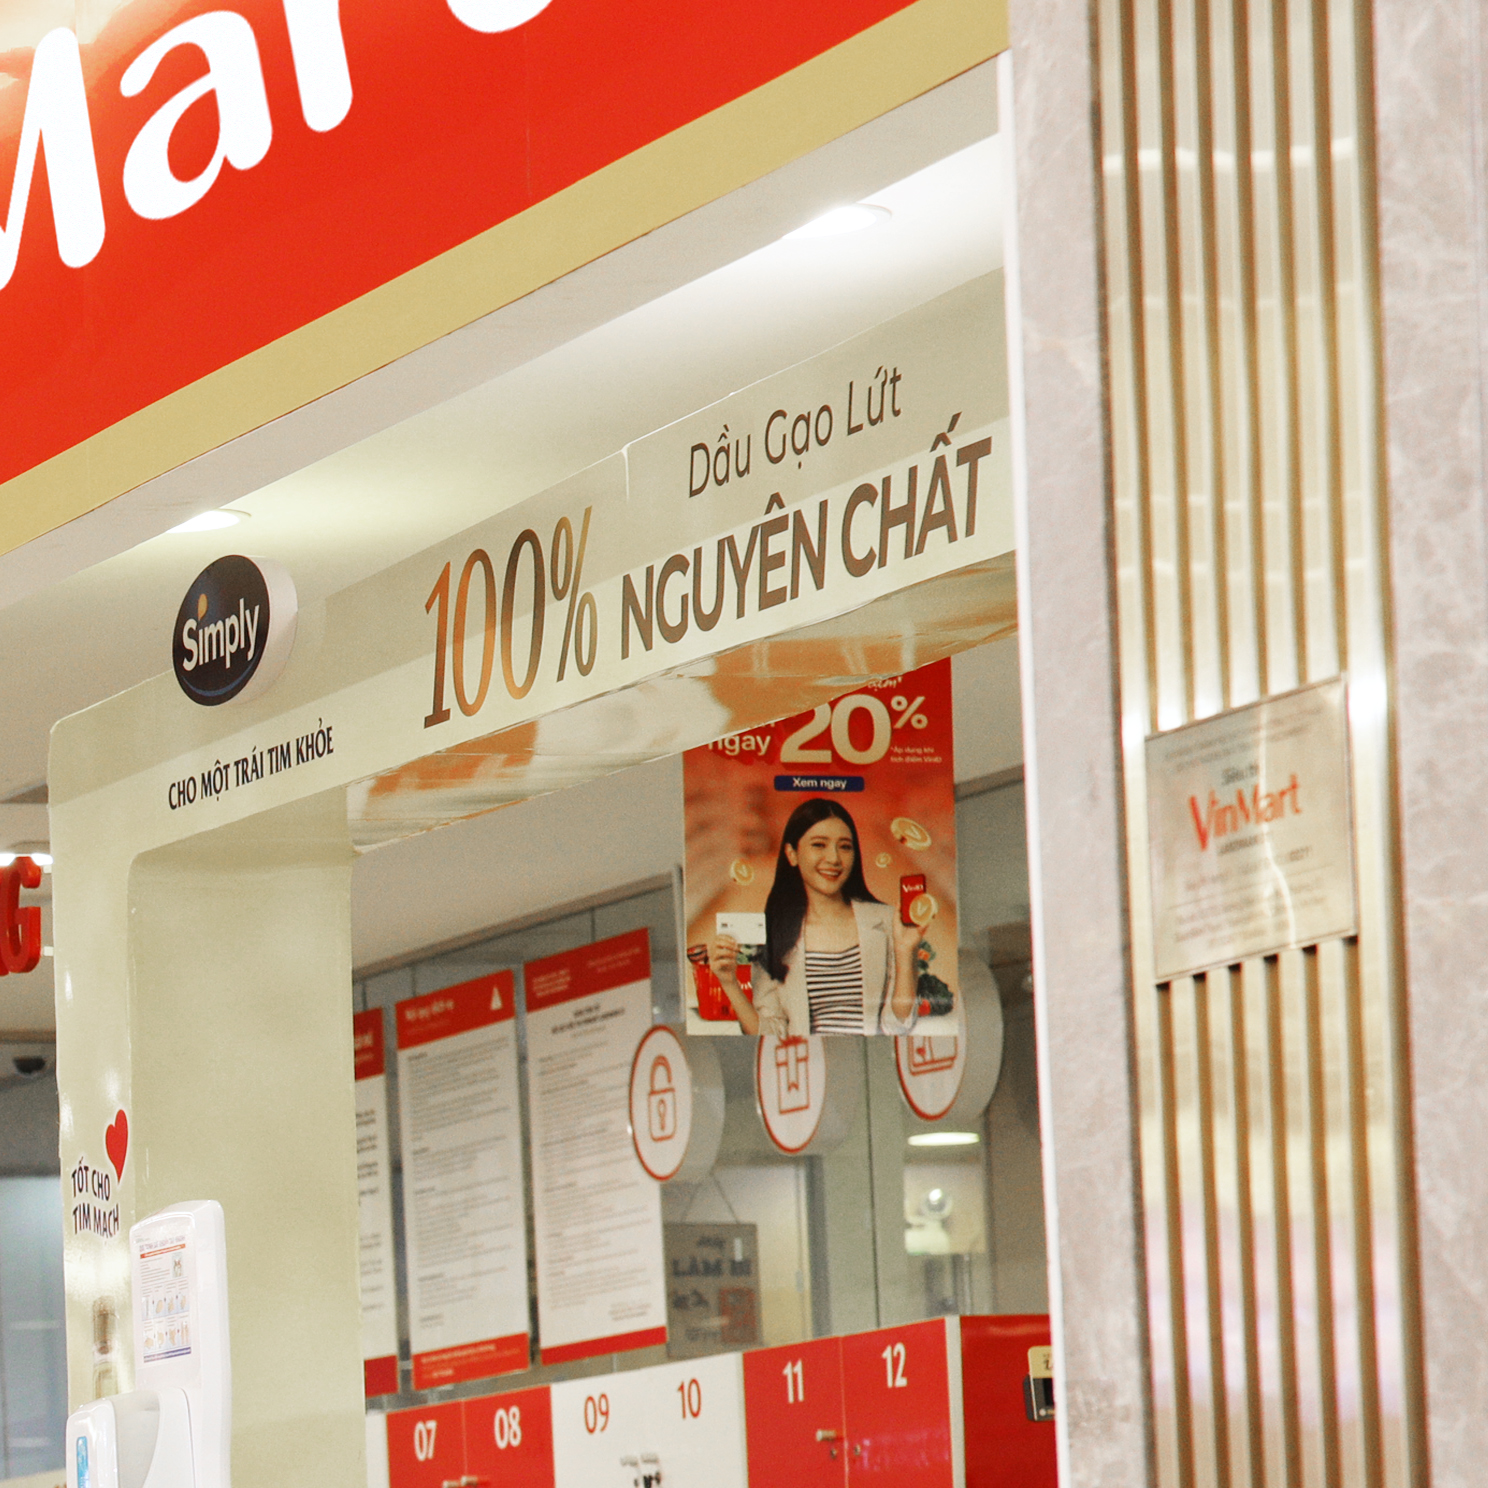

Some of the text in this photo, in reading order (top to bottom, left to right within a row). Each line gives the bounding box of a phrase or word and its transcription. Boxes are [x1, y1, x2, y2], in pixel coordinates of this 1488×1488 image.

[689, 365, 902, 498] Dầu Gạo Lứt
[423, 411, 993, 730] 100% NGUYÊN CHẤT
[182, 594, 260, 673] Simply
[168, 717, 334, 810] CHO MỘT TRÁI TIM KHỎE
[793, 777, 847, 790] Xem ngay
[71, 1156, 110, 1201] TỐT CHO
[73, 1203, 91, 1235] TIM
[783, 1359, 804, 1403] 11
[882, 1343, 908, 1388] 12
[584, 1394, 609, 1434] 09
[678, 1378, 702, 1419] 10
[414, 1420, 437, 1461] 07
[494, 1406, 521, 1449] 08
